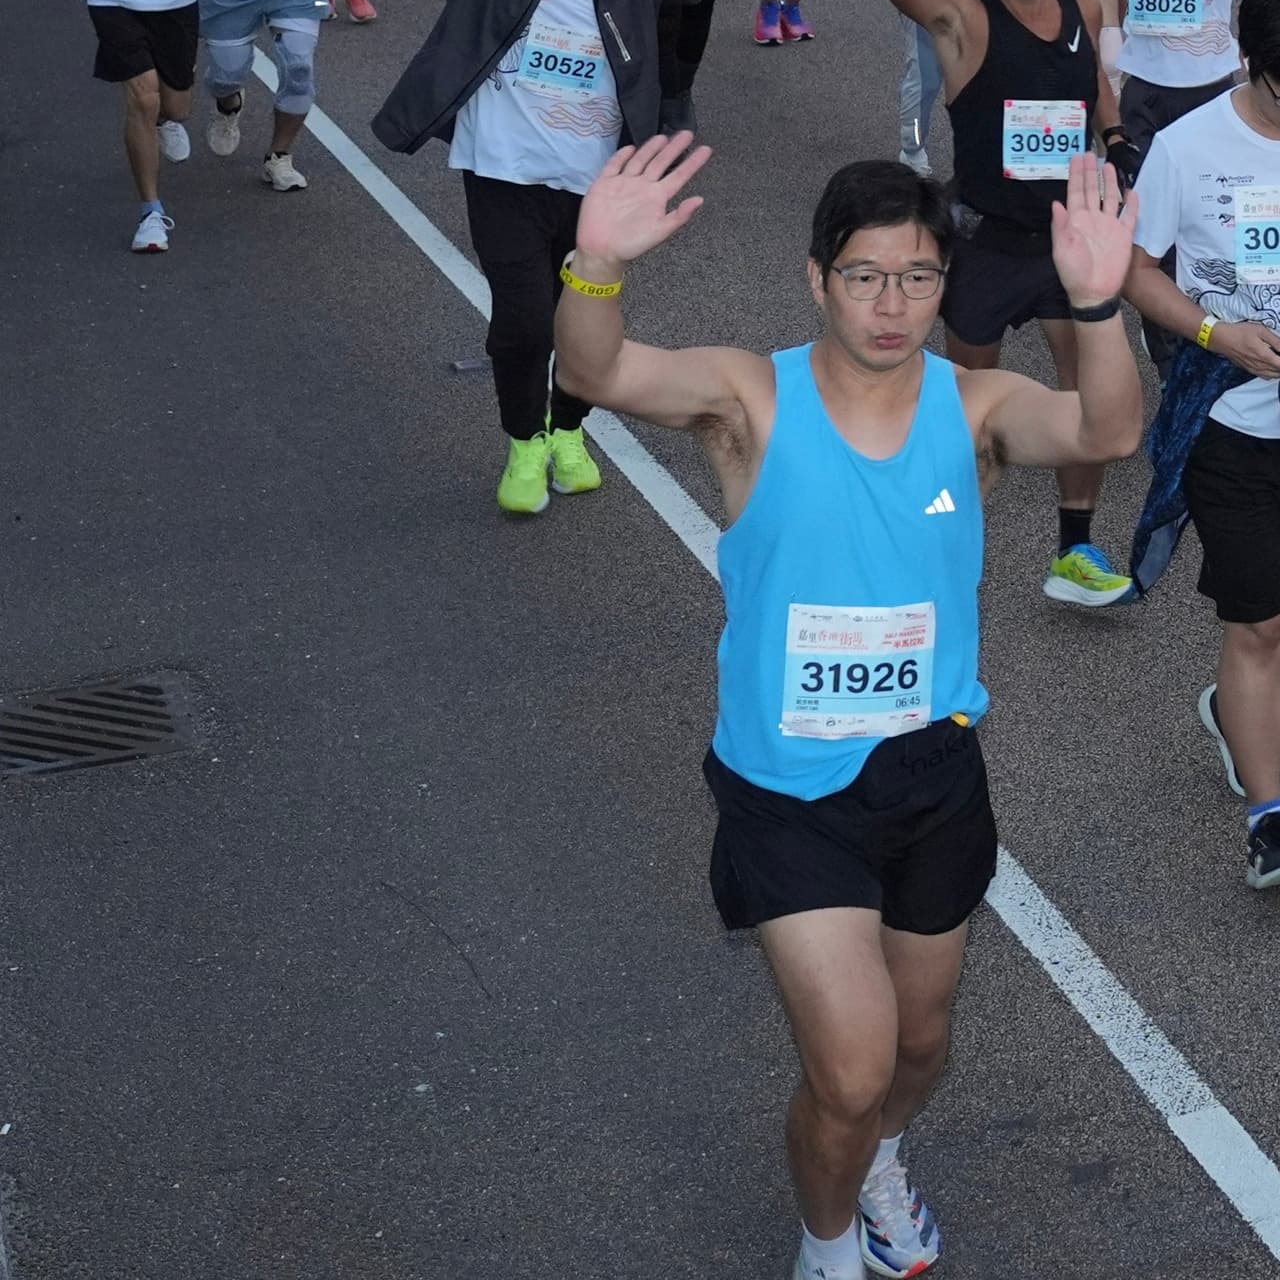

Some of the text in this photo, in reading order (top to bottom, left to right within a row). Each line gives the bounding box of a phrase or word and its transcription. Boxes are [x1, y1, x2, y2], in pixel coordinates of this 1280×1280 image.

[528, 50, 597, 80] 30522
[1010, 133, 1081, 153] 30994
[800, 658, 919, 694] 31926
[895, 696, 921, 709] 06:45
